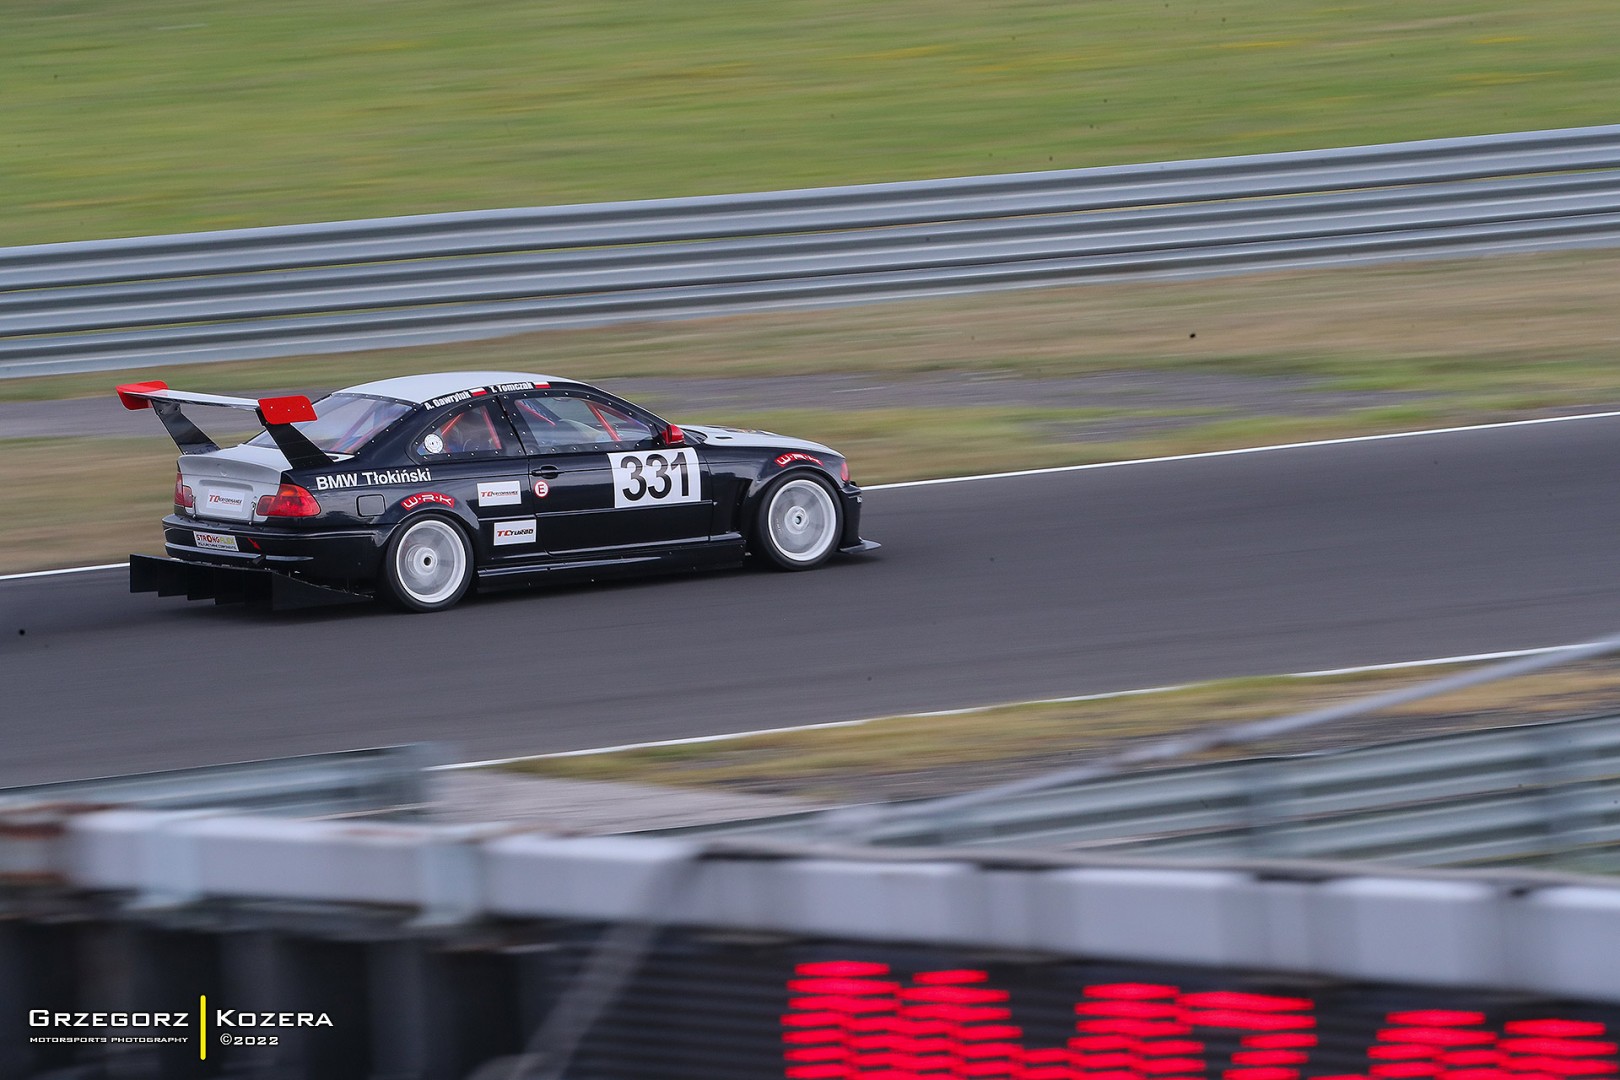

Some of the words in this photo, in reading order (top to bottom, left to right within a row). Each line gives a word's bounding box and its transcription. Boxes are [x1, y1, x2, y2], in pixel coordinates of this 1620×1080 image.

[423, 401, 434, 411] A.
[315, 473, 358, 491] BMW
[362, 467, 432, 485] Tłokiński
[620, 451, 690, 501] 331
[537, 484, 546, 495] E
